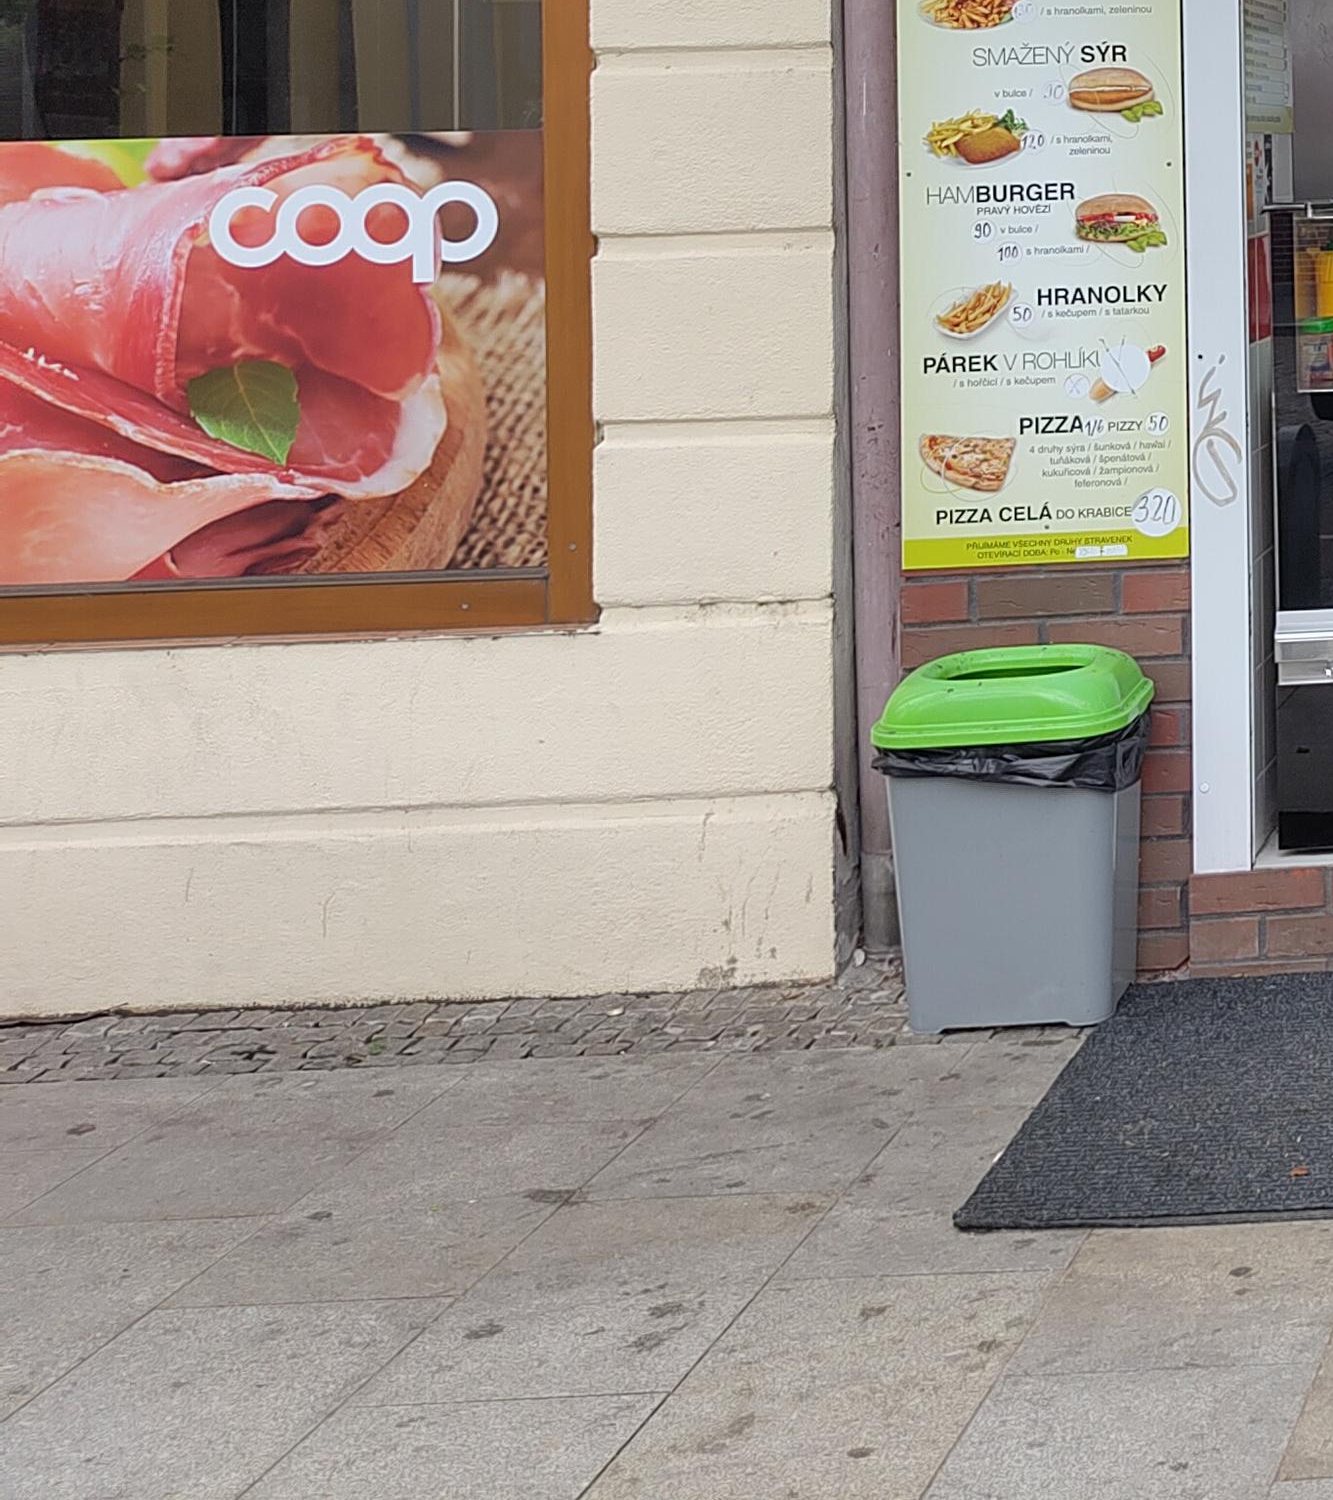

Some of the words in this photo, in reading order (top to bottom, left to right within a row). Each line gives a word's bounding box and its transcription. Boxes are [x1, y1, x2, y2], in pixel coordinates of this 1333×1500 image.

[1046, 8, 1052, 16] s
[1109, 5, 1152, 14] zeleninou
[972, 43, 1076, 67] SMAŽENÝ
[1081, 41, 1127, 63] SÝR
[1002, 89, 1027, 98] bulce
[1056, 136, 1061, 144] s
[1069, 147, 1111, 156] zeleninou
[926, 183, 1075, 205] HAMBURGER
[976, 205, 1011, 216] PRAVÝ
[1014, 204, 1051, 215] HOVĚZÍ
[209, 180, 499, 284] coop
[973, 223, 991, 240] 90
[1000, 226, 1007, 234] v
[1008, 224, 1032, 234] bulce
[997, 244, 1019, 261] 100
[1026, 248, 1032, 256] s
[1034, 245, 1084, 255] hranolkami
[1037, 284, 1167, 306] HRANOLKY
[1013, 306, 1032, 322] 50
[1048, 310, 1053, 318] s
[1056, 308, 1097, 319] kečupem
[1112, 306, 1150, 316] tatarkou
[923, 353, 999, 374] PÁREK
[1003, 354, 1018, 371] V
[1006, 378, 1012, 386] s
[1014, 376, 1056, 387] kečupem
[1019, 416, 1083, 435] PIZZA
[1108, 421, 1143, 432] PIZZY
[1148, 416, 1168, 432] 50
[1037, 445, 1065, 455] druhy
[1066, 443, 1085, 454] sýra
[1094, 441, 1130, 452] šunková
[1099, 453, 1146, 465] špenátová
[1042, 467, 1091, 477] kukuřicová
[1099, 464, 1154, 476] žampionová
[936, 509, 992, 525] PIZZA
[999, 502, 1051, 522] CELÁ
[1056, 509, 1075, 519] DO
[1078, 506, 1132, 519] KRABICE
[1135, 495, 1176, 525] 320
[1054, 538, 1082, 546] DRUHY
[1084, 535, 1133, 545] STRAVENEK
